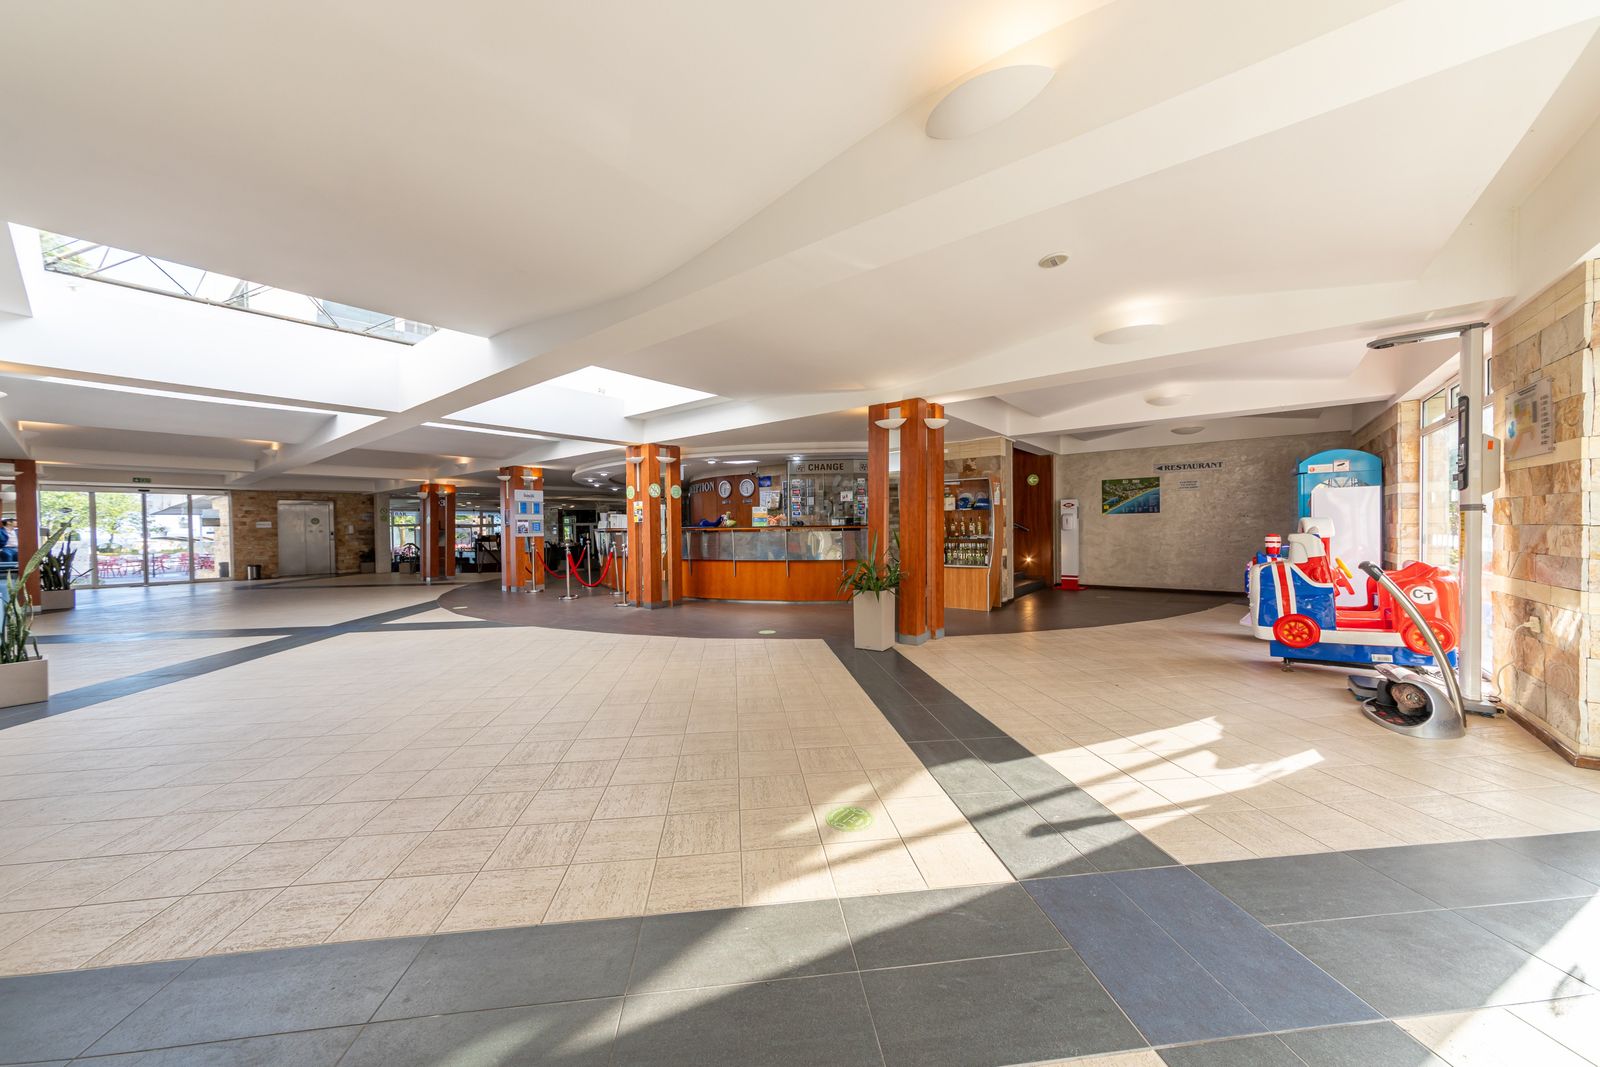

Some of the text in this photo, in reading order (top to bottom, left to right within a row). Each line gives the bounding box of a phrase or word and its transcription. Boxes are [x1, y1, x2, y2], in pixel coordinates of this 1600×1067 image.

[808, 463, 844, 471] CHANGE
[1164, 461, 1223, 471] RESTAURANT
[1412, 588, 1433, 601] CT
